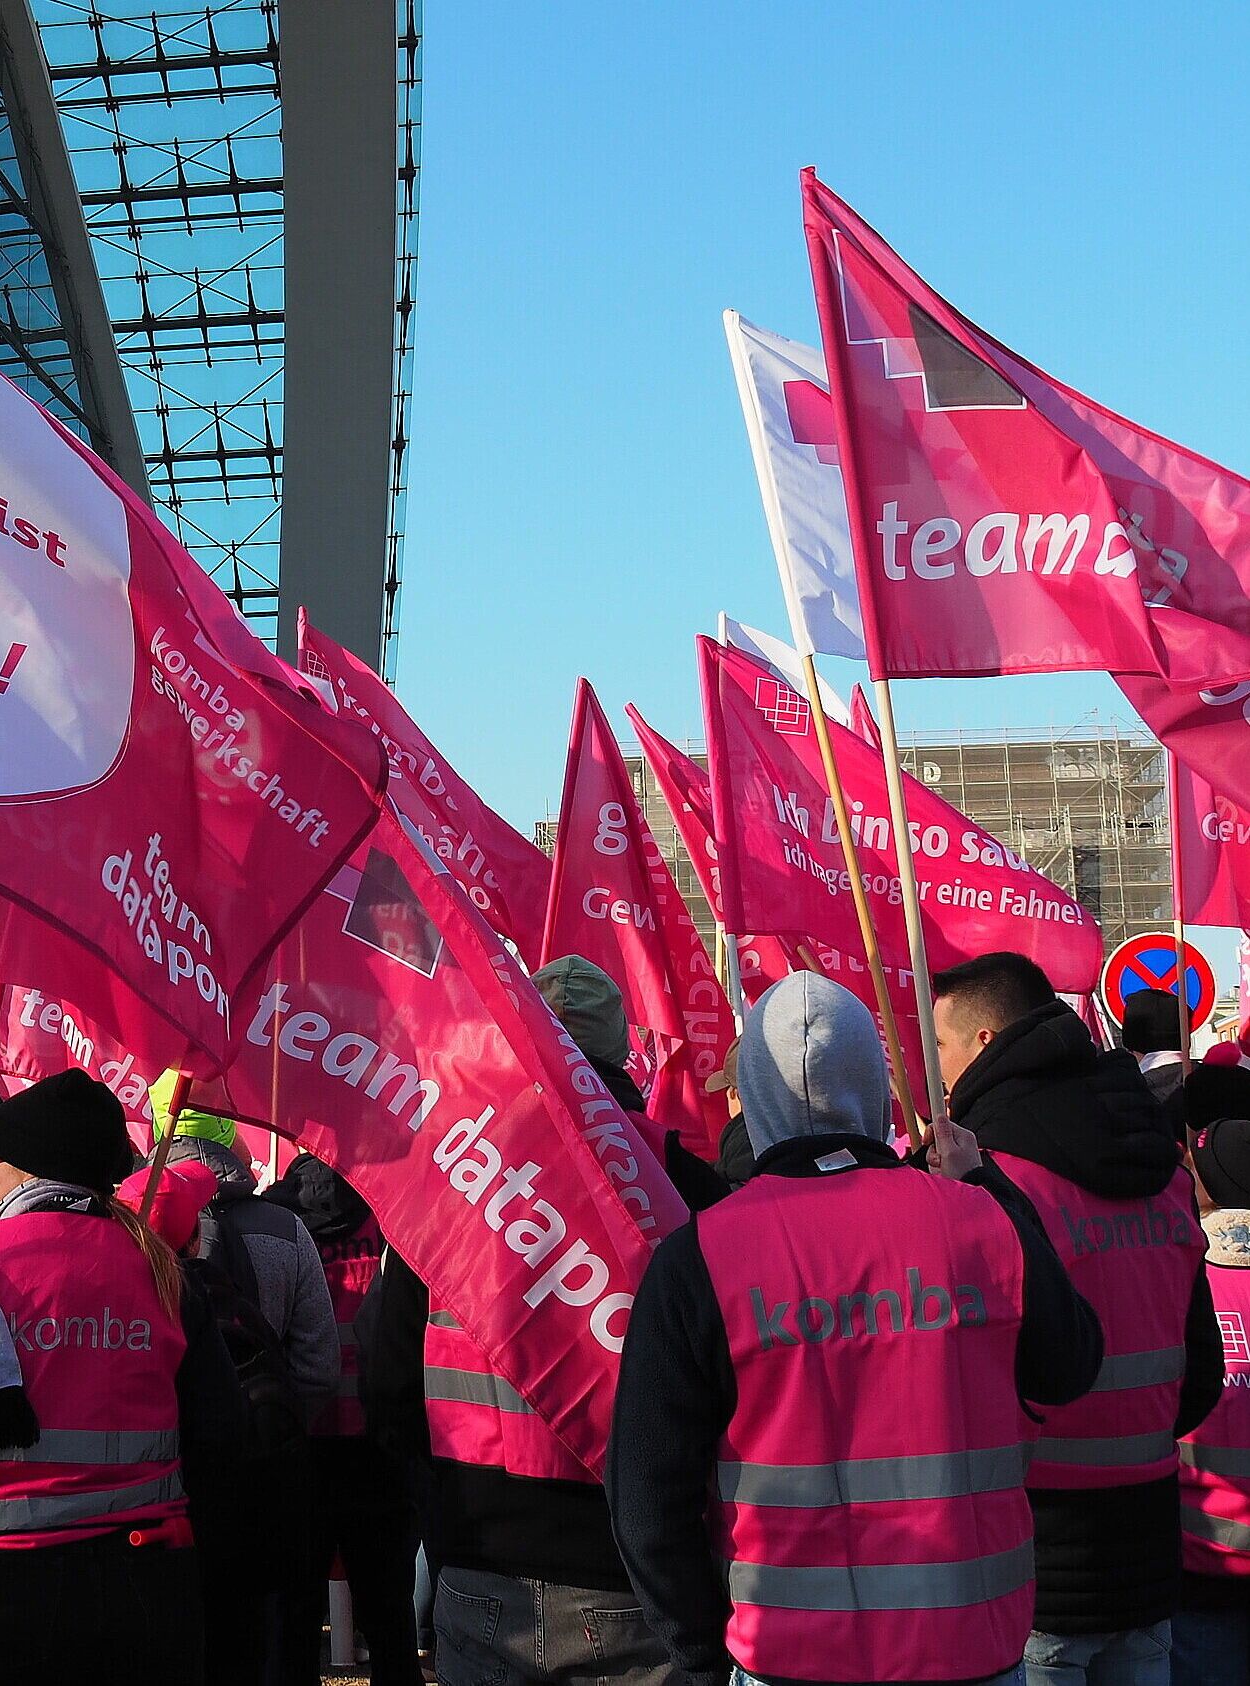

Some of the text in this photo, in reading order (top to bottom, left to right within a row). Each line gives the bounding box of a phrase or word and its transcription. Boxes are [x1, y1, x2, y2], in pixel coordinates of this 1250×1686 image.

[877, 501, 1091, 580] team
[151, 627, 245, 731] komba
[152, 665, 329, 847] gewerkschaft
[773, 784, 809, 839] Ich
[960, 831, 1032, 873] sau
[144, 832, 212, 955] team
[783, 838, 1083, 925] ich trage sogr eine Fahne!
[102, 850, 230, 1041] datapor
[20, 989, 94, 1067] team
[246, 982, 634, 1353] team datapo
[1061, 1200, 1191, 1257] komba
[10, 1307, 151, 1351] komba
[749, 1267, 987, 1351] komba
